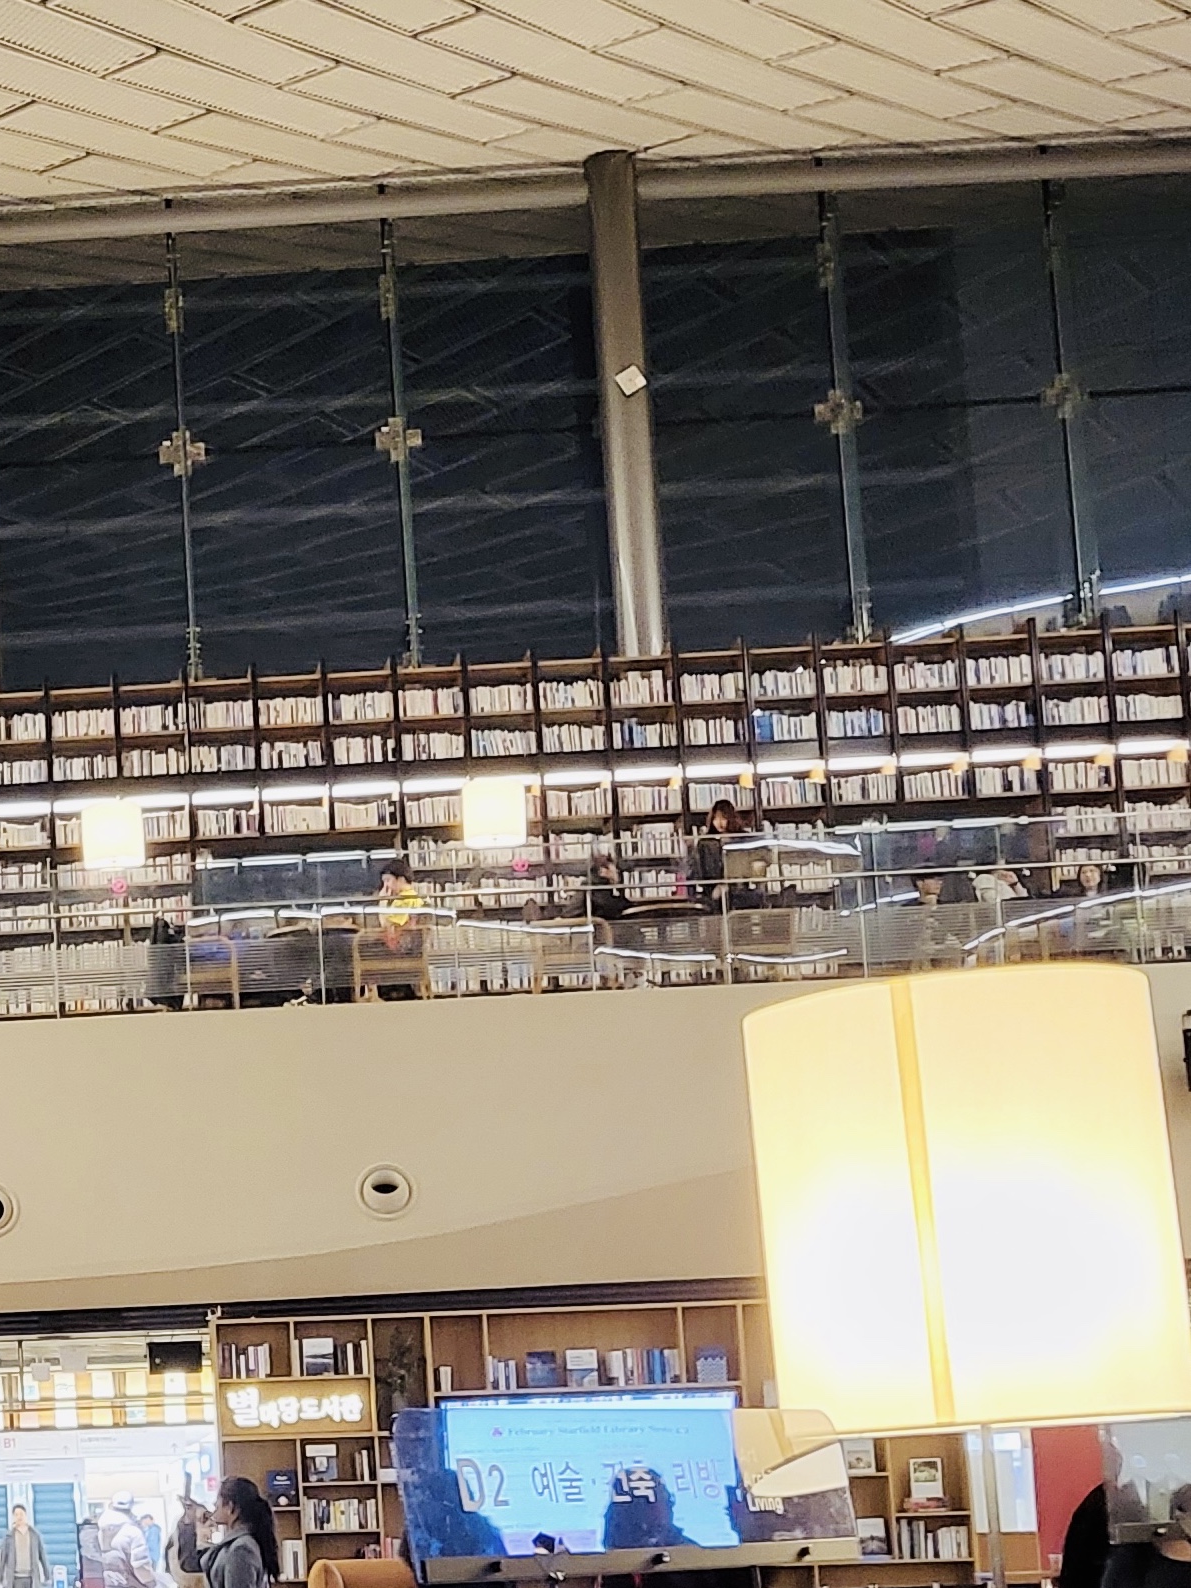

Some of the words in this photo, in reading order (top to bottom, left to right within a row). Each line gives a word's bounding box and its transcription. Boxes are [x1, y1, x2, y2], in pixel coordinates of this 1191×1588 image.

[2, 1437, 17, 1449] B1
[455, 1457, 510, 1514] D2
[746, 1491, 785, 1515] Living
